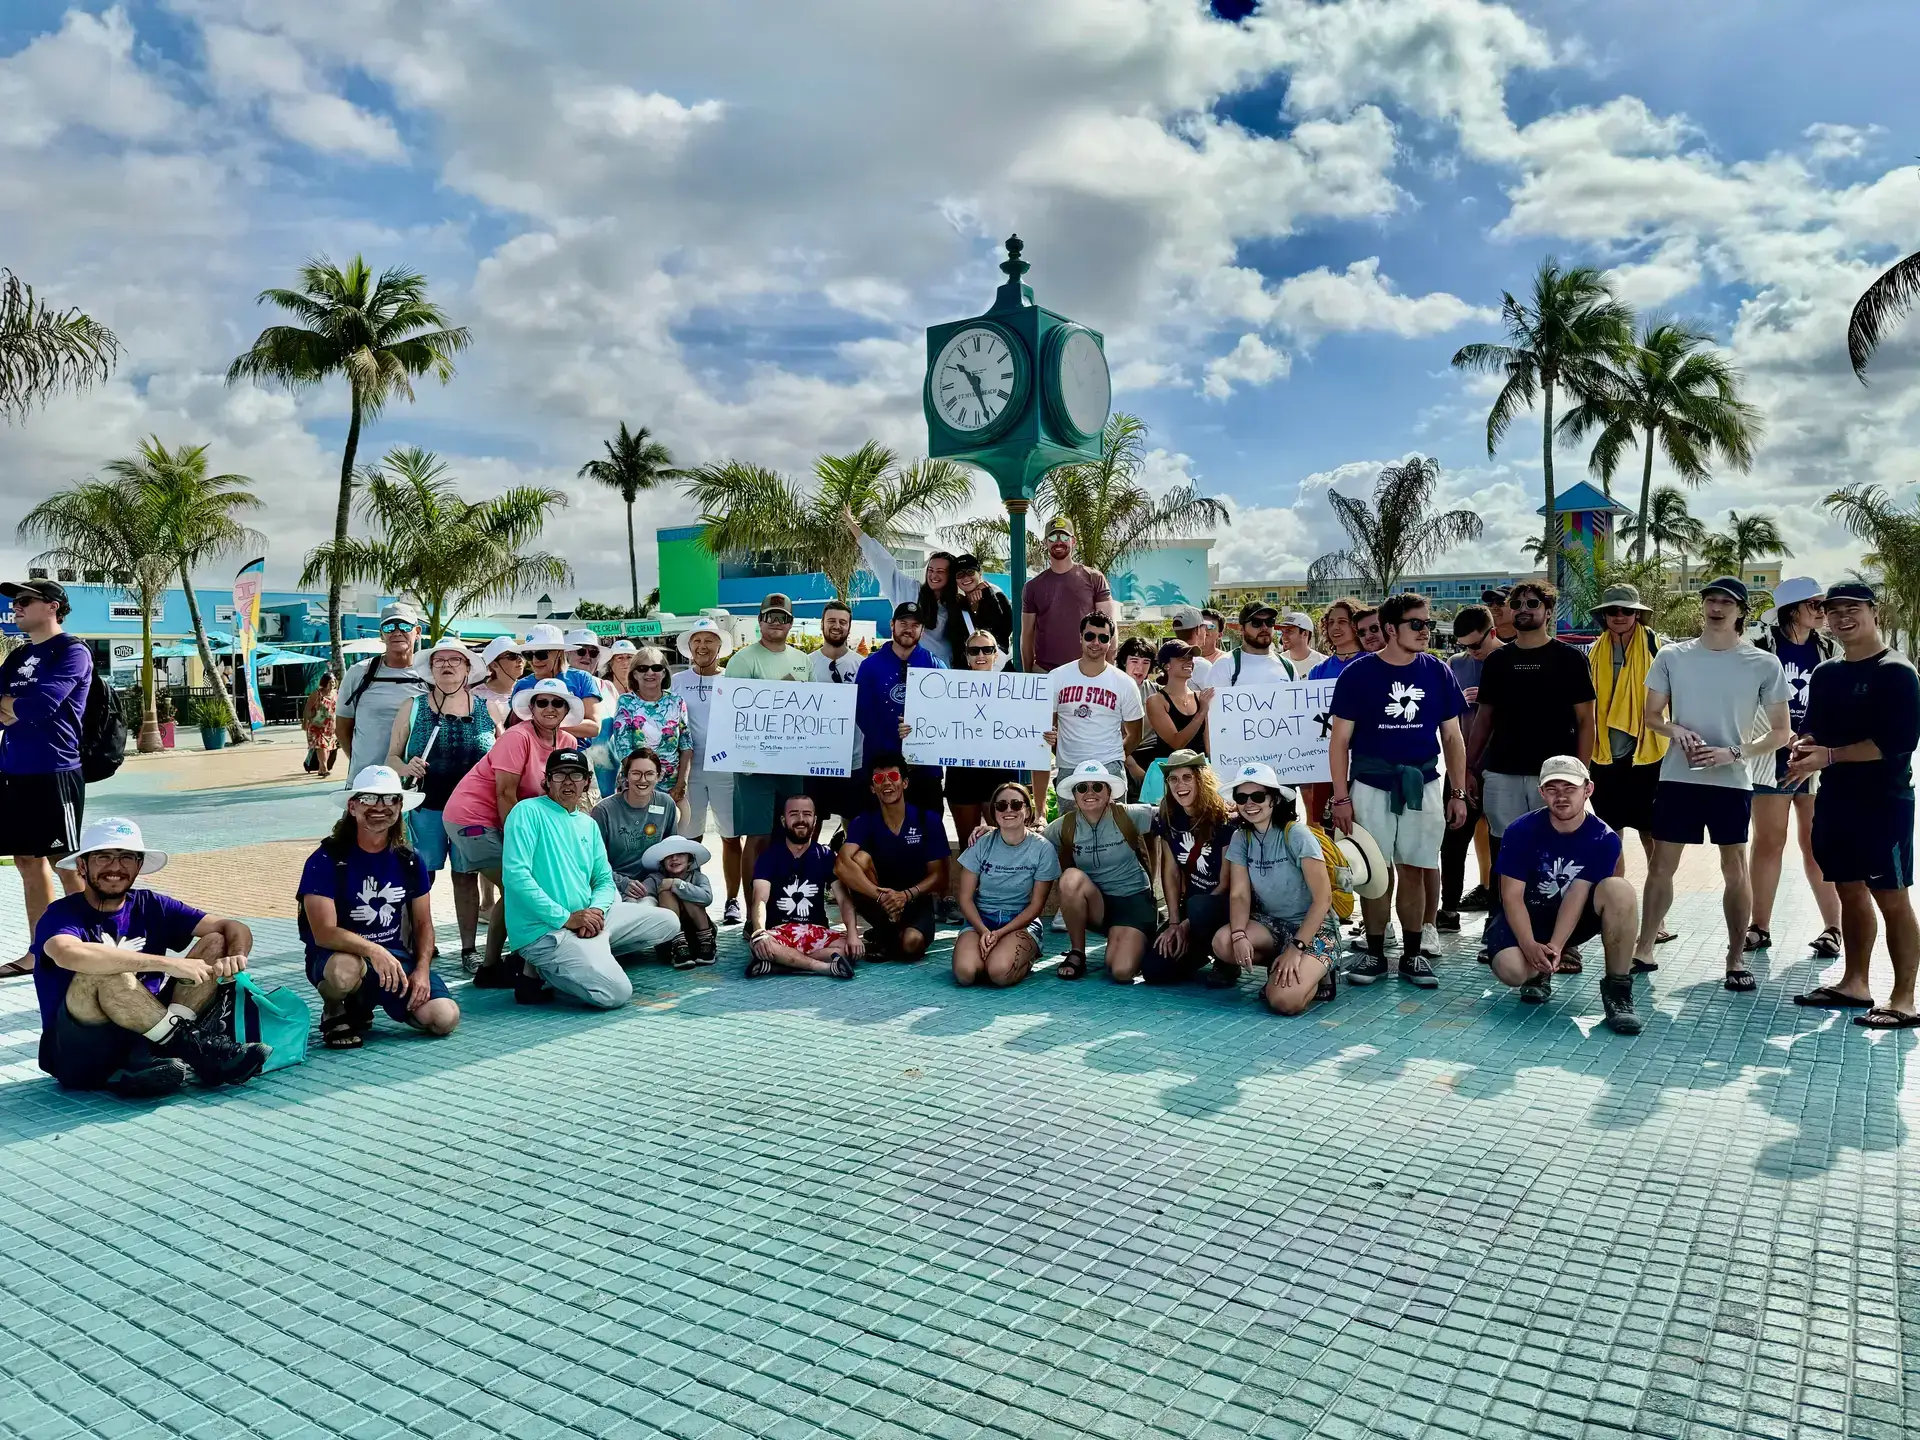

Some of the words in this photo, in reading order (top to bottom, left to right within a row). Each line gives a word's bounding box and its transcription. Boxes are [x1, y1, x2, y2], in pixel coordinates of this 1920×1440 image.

[602, 624, 619, 632] CREAM
[627, 626, 635, 634] ICE
[637, 624, 655, 633] CREAM
[918, 672, 992, 699] OCEAN
[997, 674, 1048, 701] BLUE
[732, 686, 824, 711] OCEAN
[1058, 685, 1083, 704] OHIO
[1085, 687, 1117, 710] STATE
[1221, 691, 1276, 713] ROW
[1285, 686, 1335, 711] THE
[973, 703, 987, 721] X
[734, 711, 777, 733] BLUE
[782, 713, 849, 736] PROJECT
[915, 717, 949, 739] Row
[951, 721, 983, 740] The
[993, 721, 1041, 740] Boat
[1243, 715, 1305, 740] BOAT
[711, 751, 728, 763] RTB
[938, 757, 957, 766] KEEP
[961, 758, 975, 767] THE
[978, 759, 1001, 768] OCEAN
[1003, 760, 1026, 768] CLEAN
[1288, 747, 1329, 760] Ownershi
[809, 766, 845, 776] GARTNER
[1273, 763, 1316, 776] lopment
